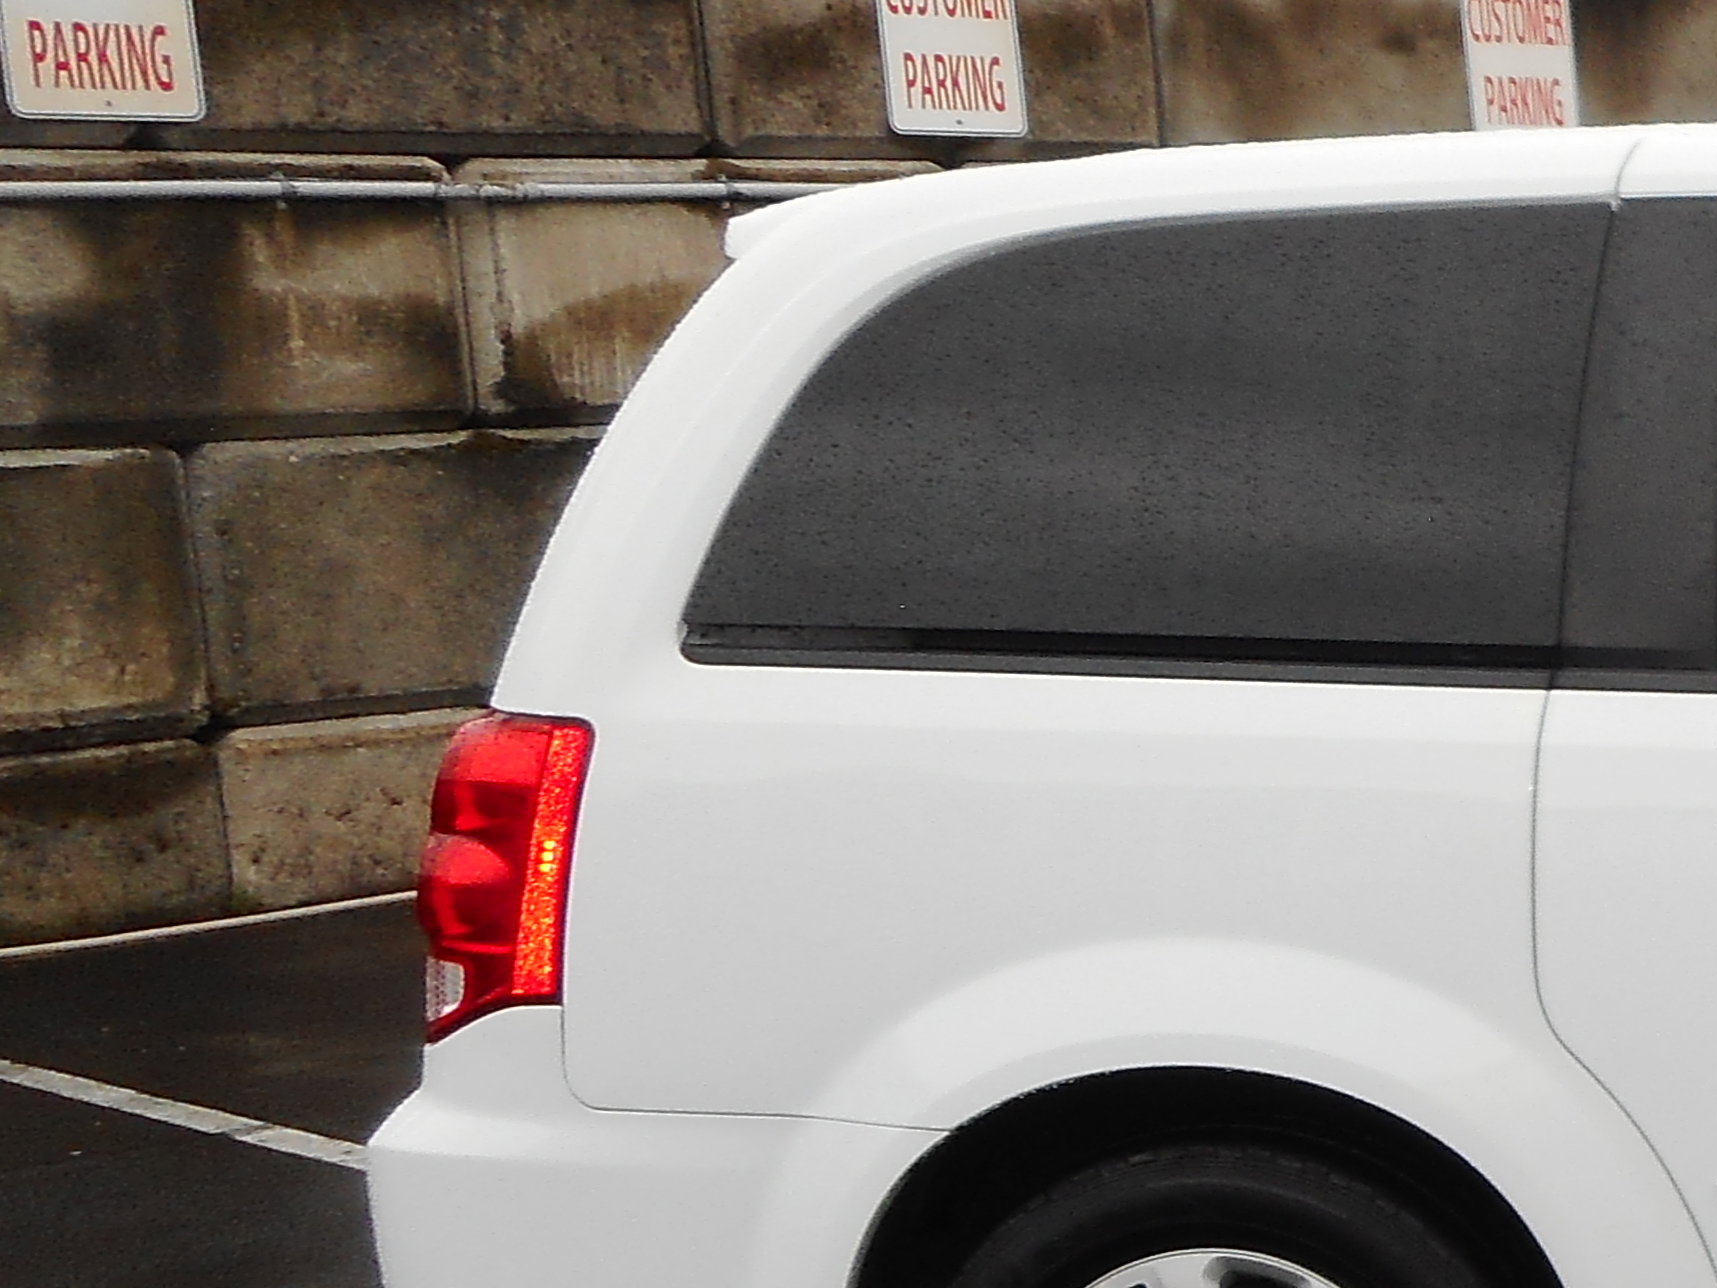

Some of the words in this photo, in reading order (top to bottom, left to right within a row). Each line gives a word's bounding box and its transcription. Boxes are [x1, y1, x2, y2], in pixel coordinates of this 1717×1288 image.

[26, 20, 176, 92] PARKING
[903, 52, 1007, 112] PARKING
[1484, 75, 1565, 126] PARKING
